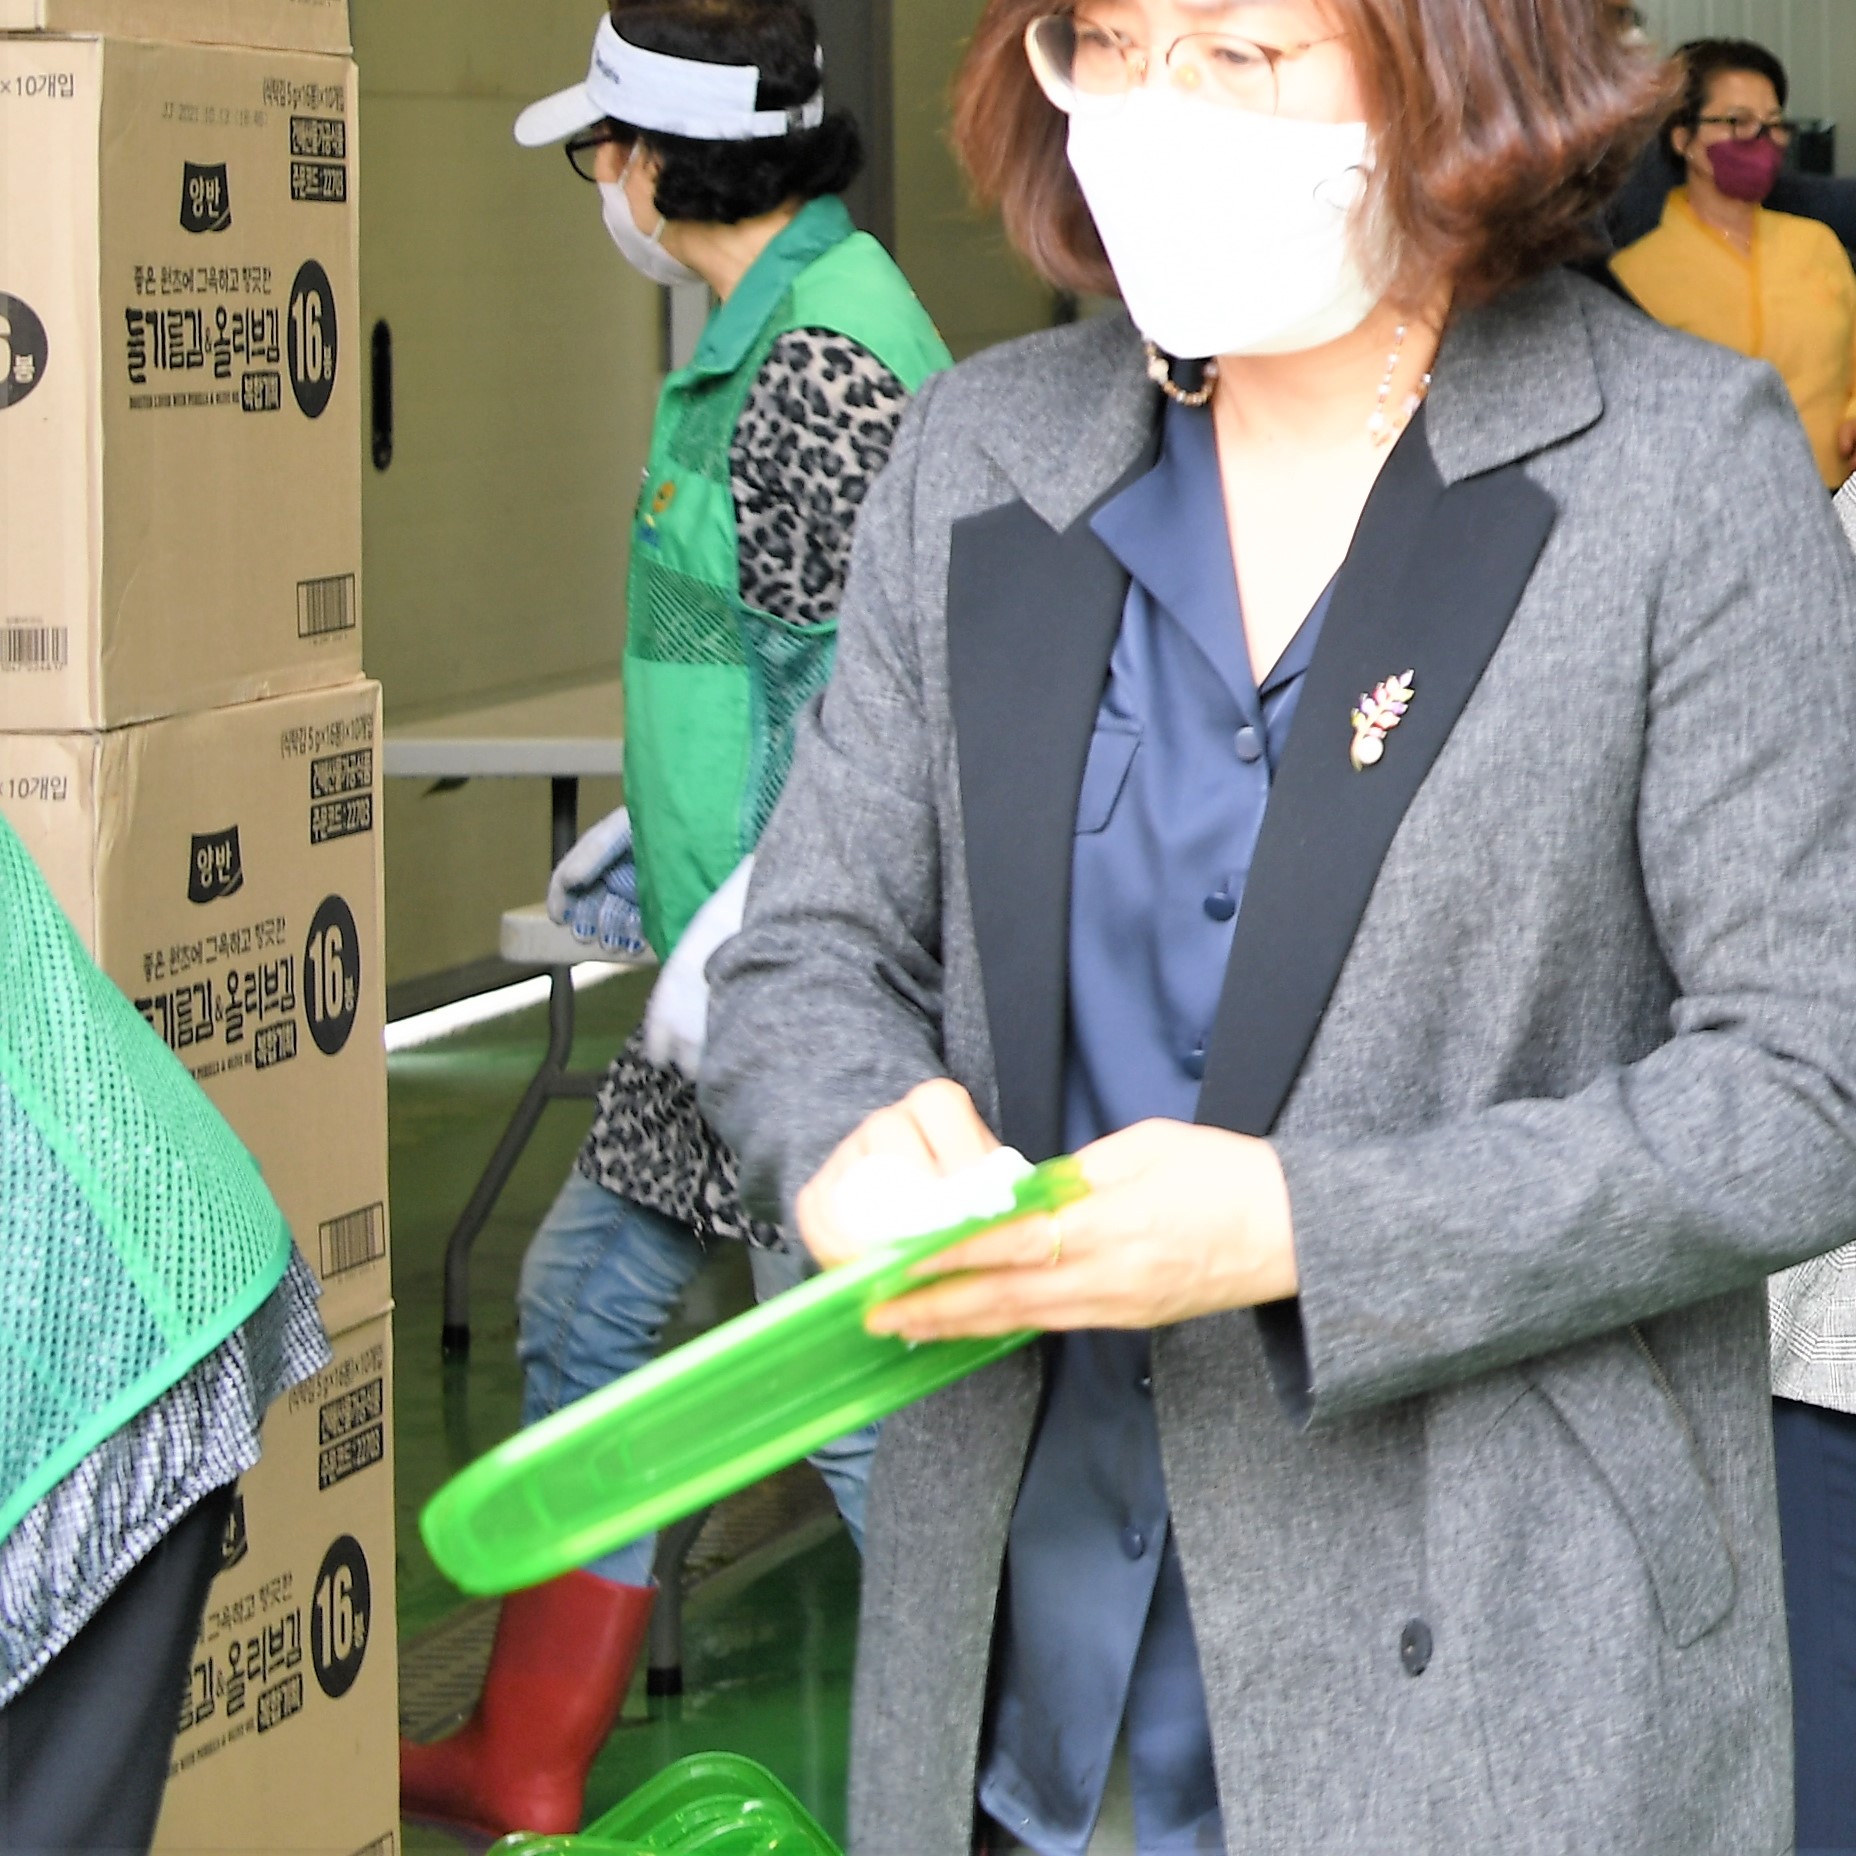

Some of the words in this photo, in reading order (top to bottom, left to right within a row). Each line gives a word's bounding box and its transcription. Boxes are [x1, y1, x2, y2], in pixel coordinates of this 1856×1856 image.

[189, 175, 221, 219] 양반
[133, 265, 156, 296] 좋은
[160, 265, 194, 295] 원초에
[196, 265, 240, 295] 그윽하고
[196, 839, 233, 888] 양반
